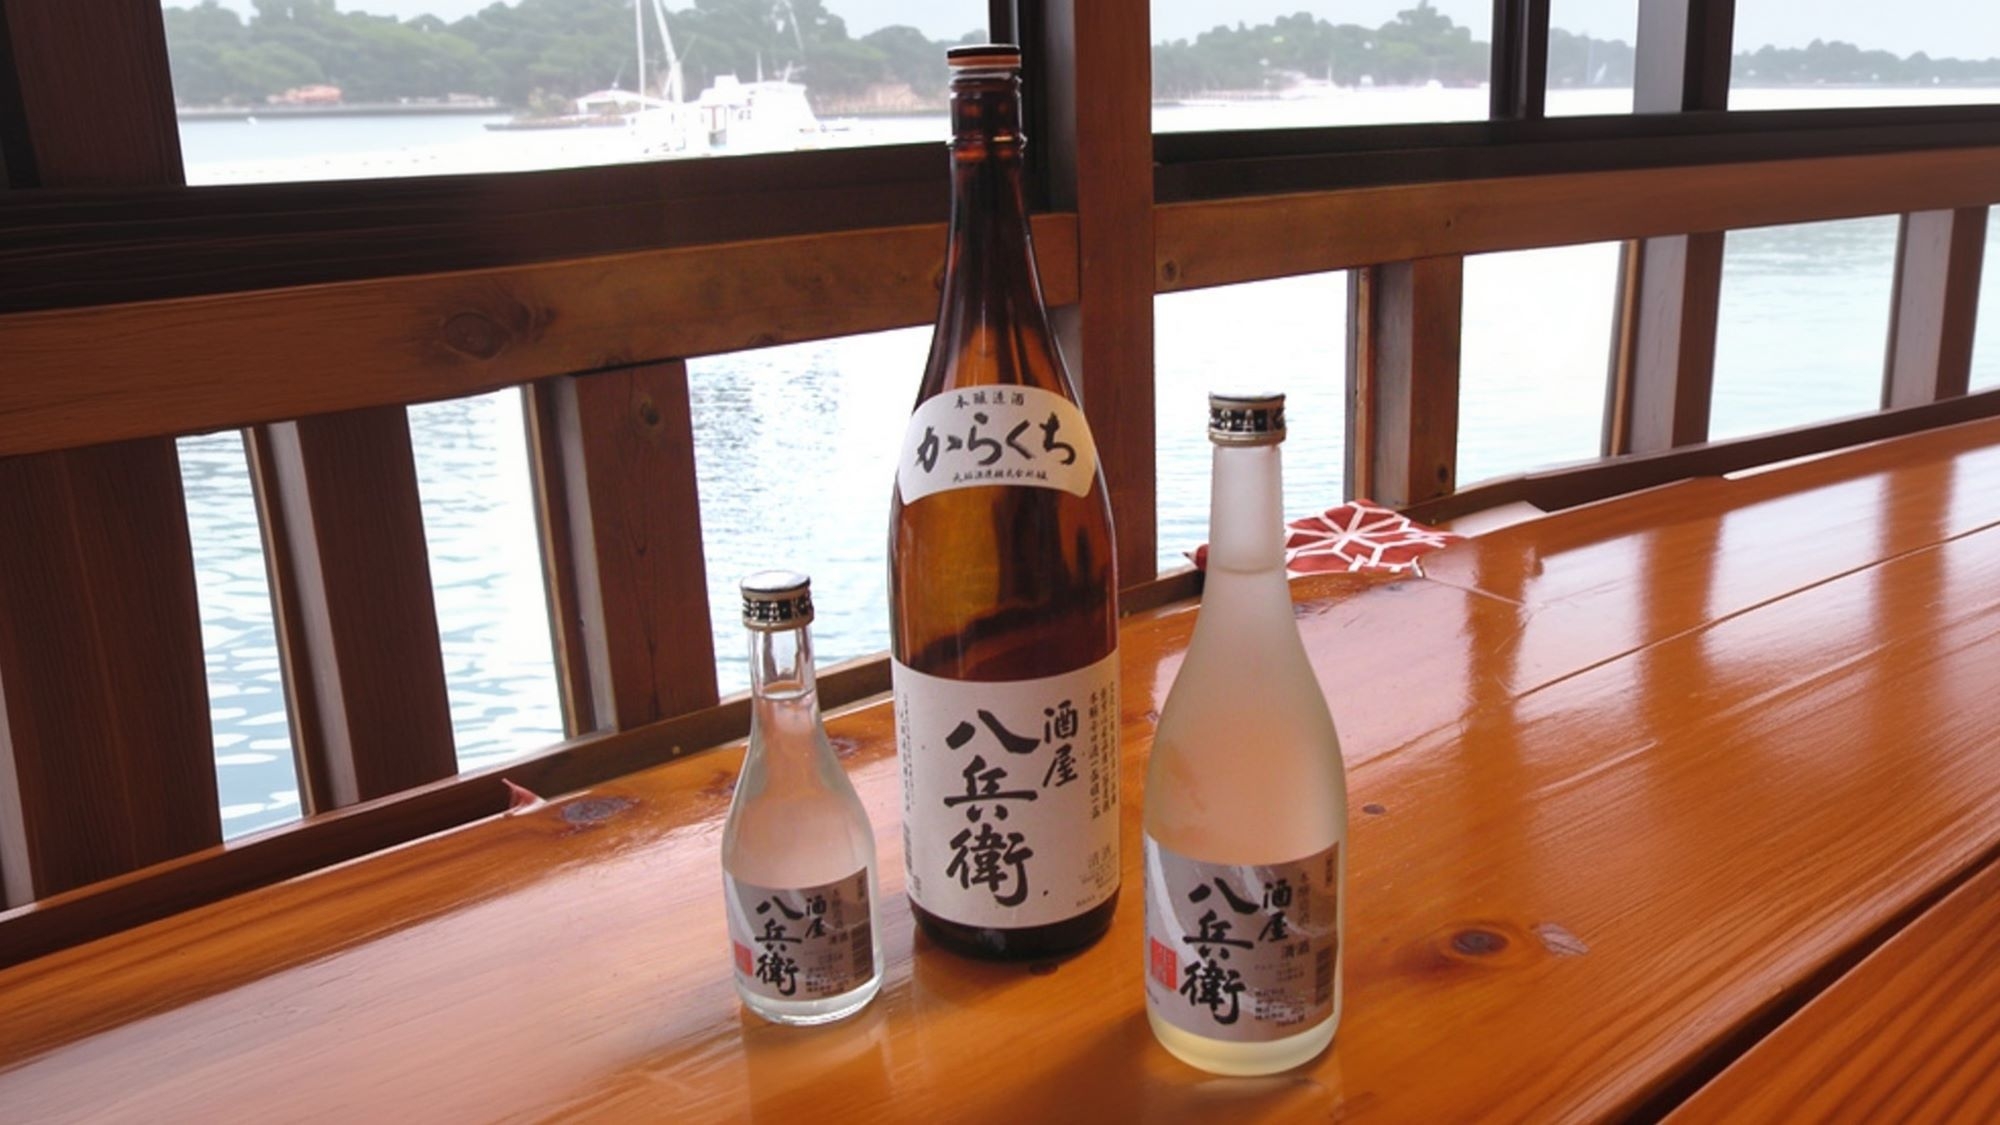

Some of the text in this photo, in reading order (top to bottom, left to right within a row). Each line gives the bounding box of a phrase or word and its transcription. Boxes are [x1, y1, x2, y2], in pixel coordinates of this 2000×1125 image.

[915, 412, 1077, 474] からくち
[1042, 699, 1078, 788] 酒屋
[943, 708, 1041, 907] 八兵衛
[755, 895, 804, 996] 八兵衛
[1180, 877, 1260, 1025] 八兵衛
[1258, 878, 1292, 942] 酒屋
